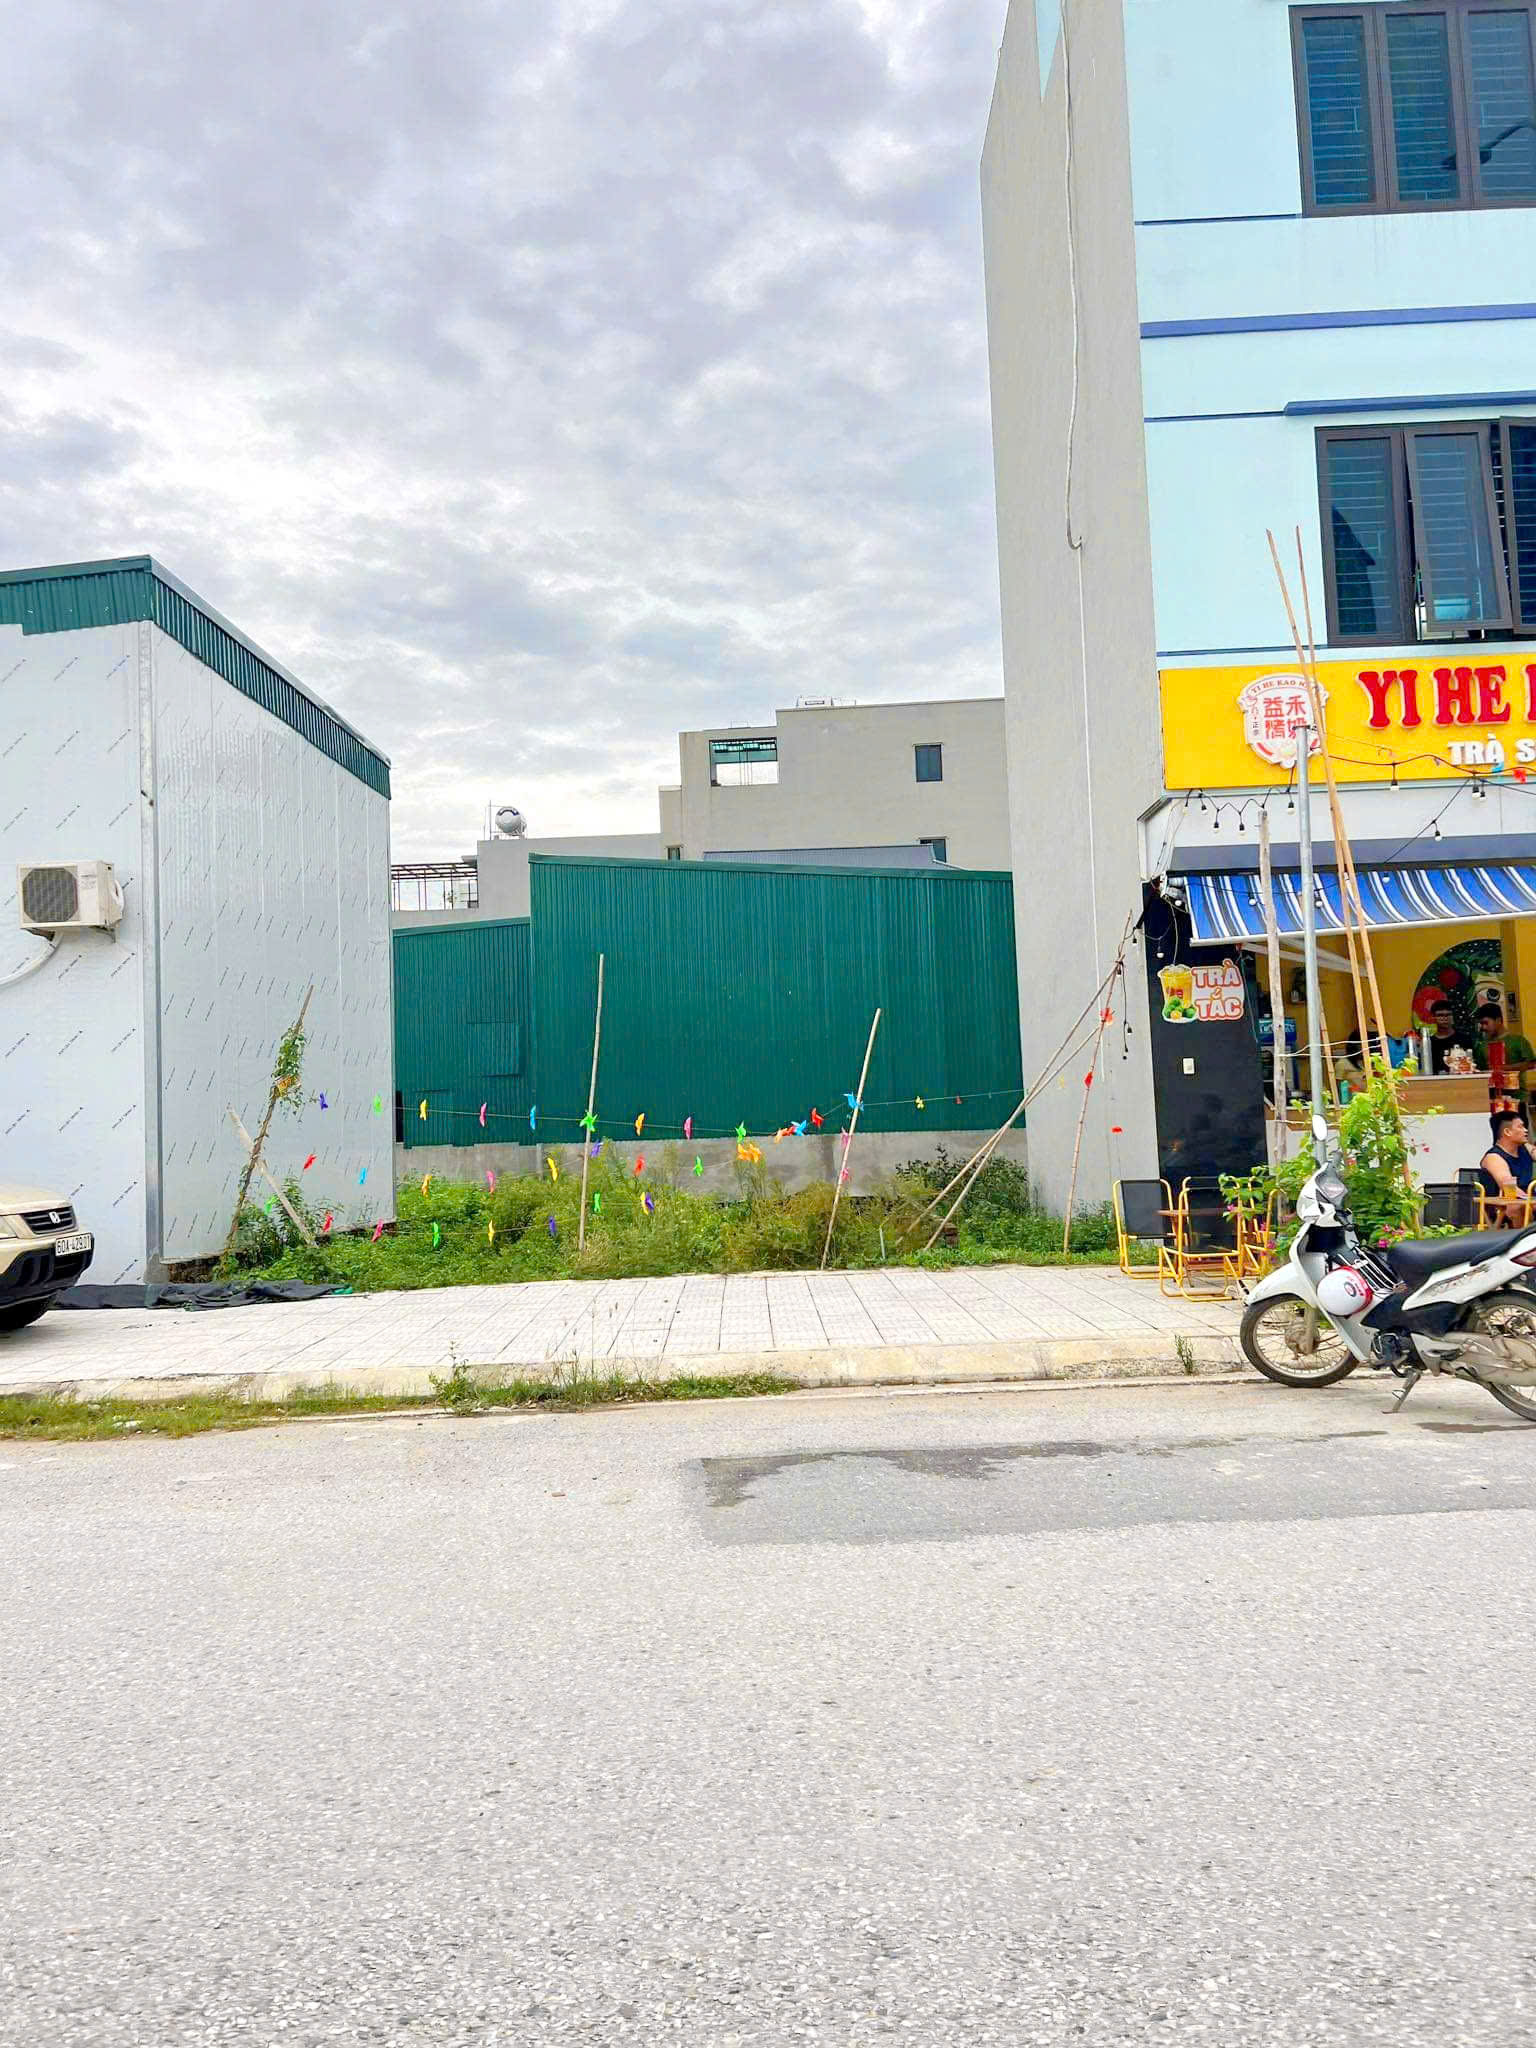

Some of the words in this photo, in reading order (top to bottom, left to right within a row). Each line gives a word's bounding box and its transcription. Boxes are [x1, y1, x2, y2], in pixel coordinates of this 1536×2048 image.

[1357, 669, 1421, 728] YI
[1433, 665, 1511, 725] HE
[1448, 732, 1505, 765] TRÀ
[1191, 959, 1241, 988] TRÀ
